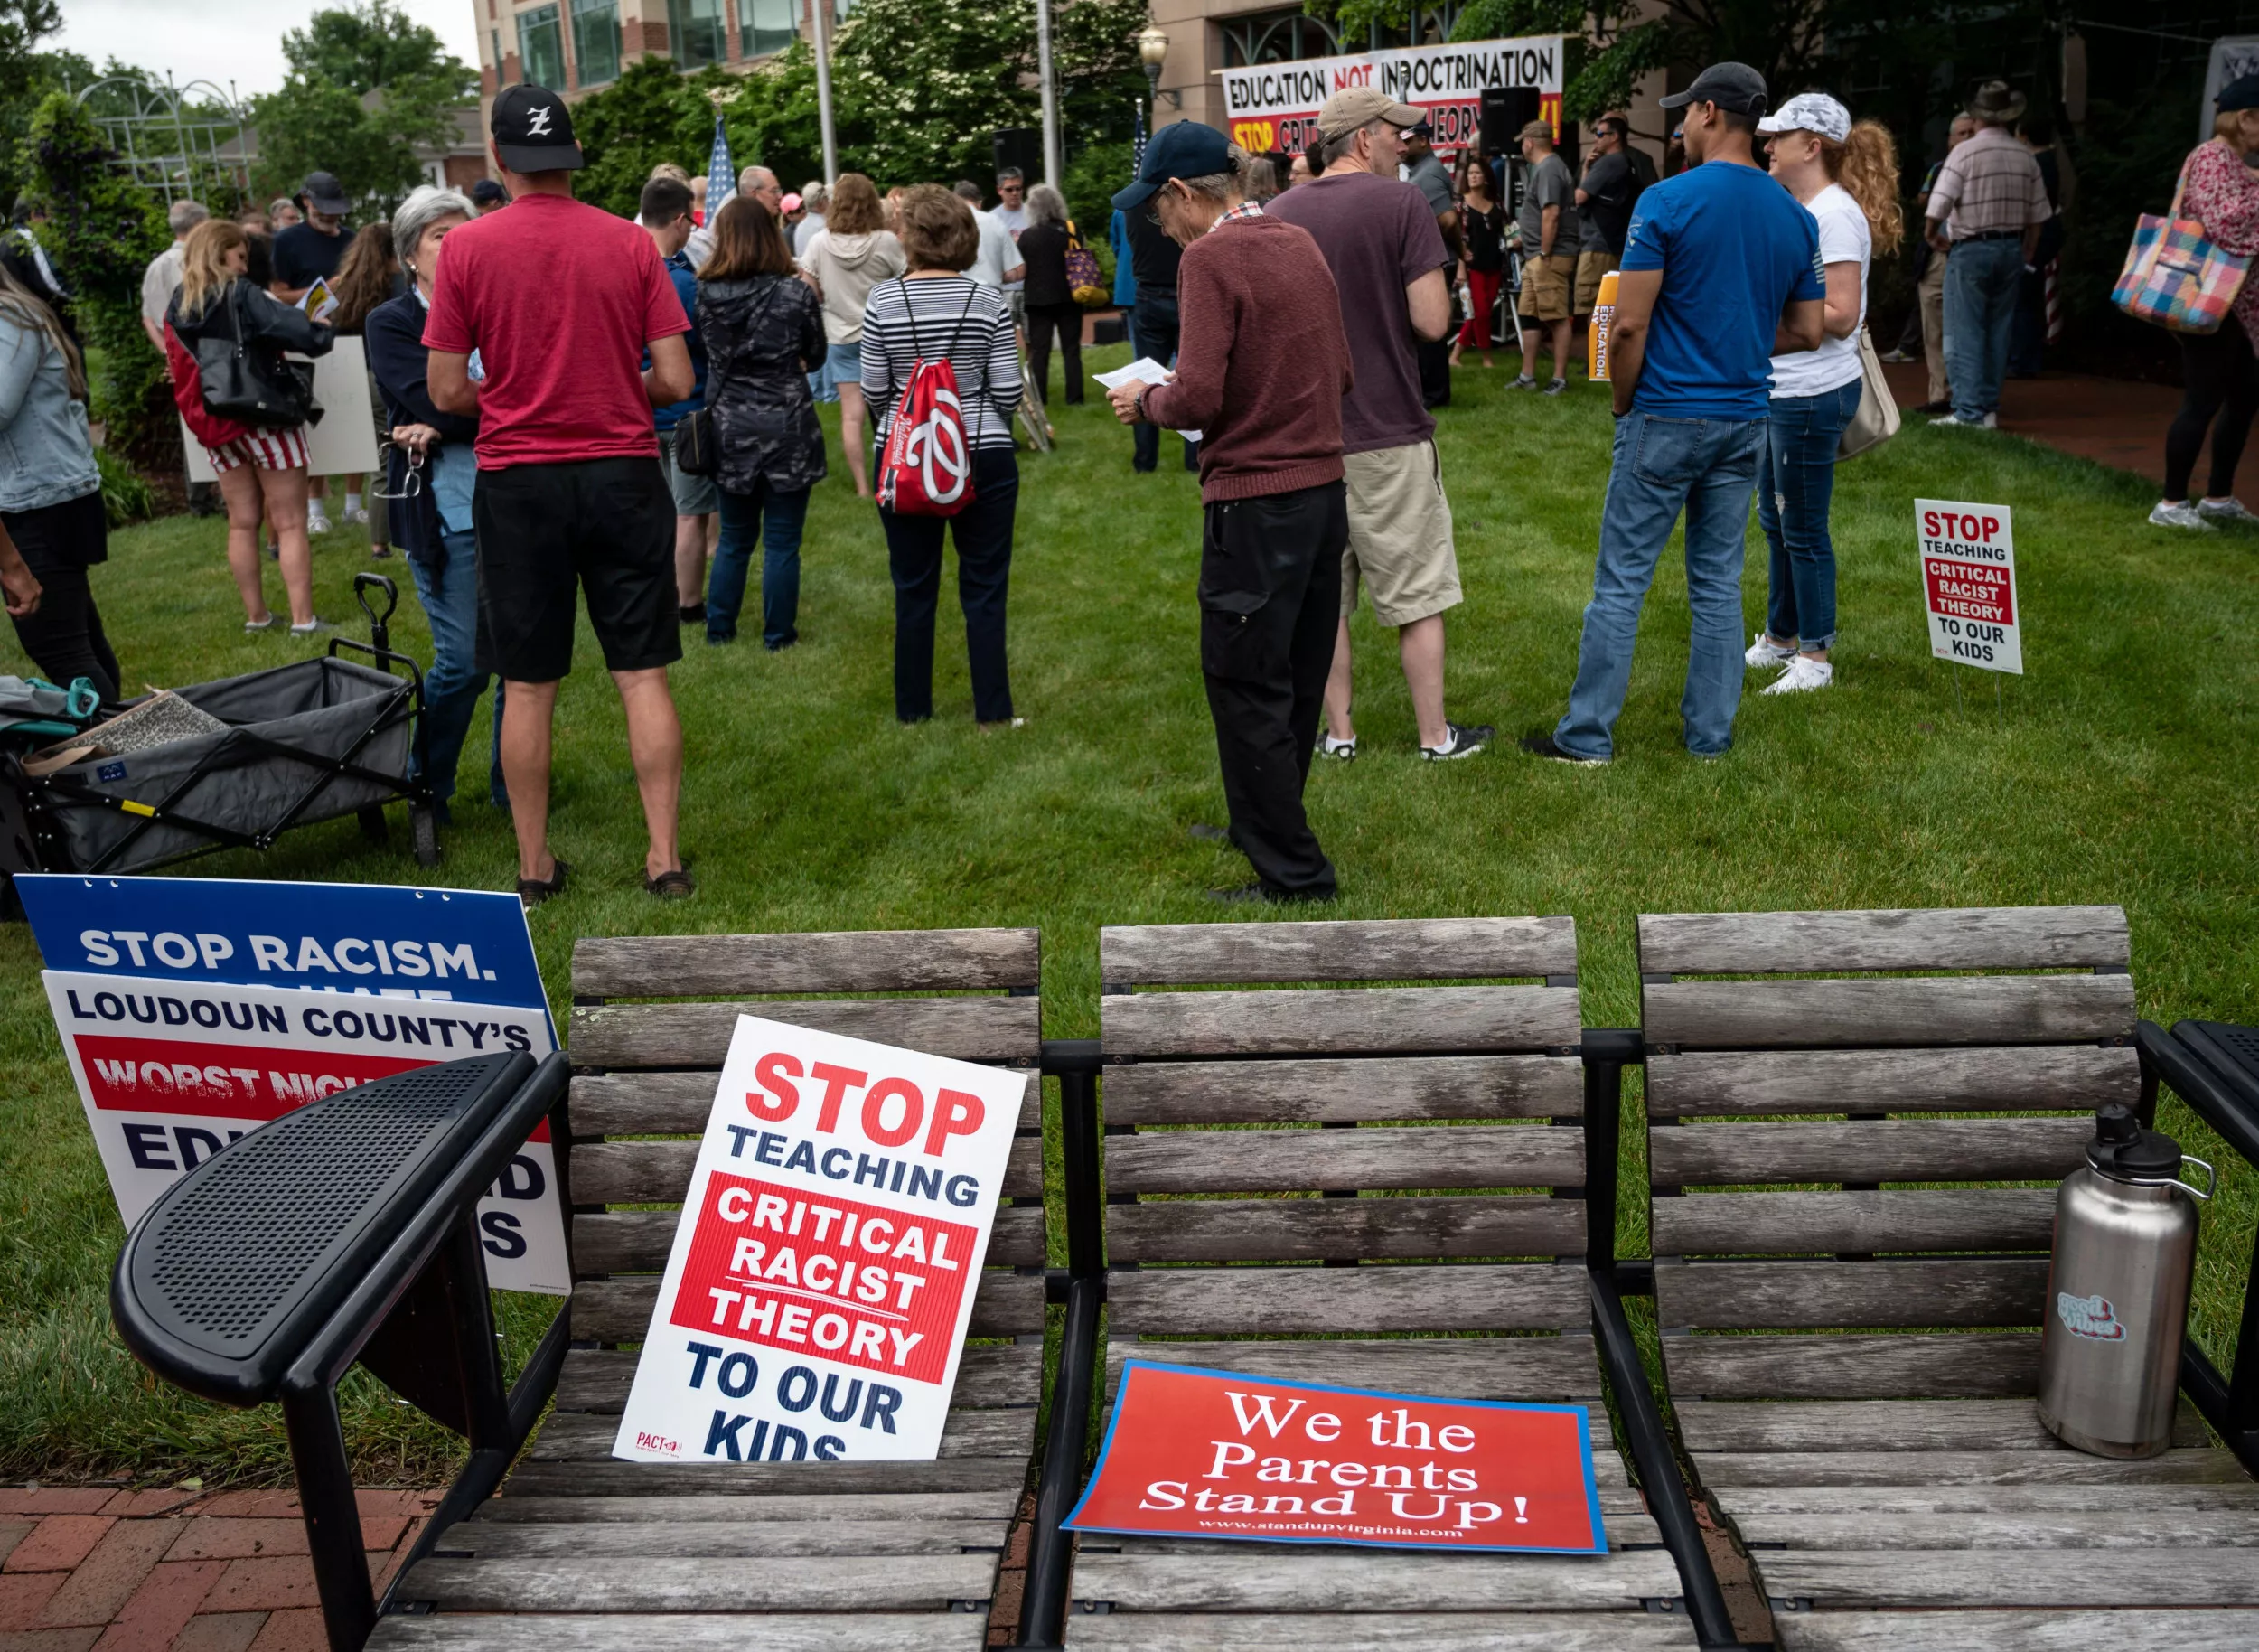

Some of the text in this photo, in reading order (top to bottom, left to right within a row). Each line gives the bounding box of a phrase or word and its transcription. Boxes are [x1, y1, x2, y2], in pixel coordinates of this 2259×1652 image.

[1229, 47, 1553, 109] EDUCATION NOT INDOCTRINATION
[526, 106, 553, 136] Z
[1233, 122, 1273, 153] STOP
[1596, 305, 1609, 378] EDUCATION
[1924, 511, 2000, 543] STOP
[1924, 540, 2006, 561] TEACHING
[1929, 561, 2008, 586] CRITICAL
[1939, 579, 2000, 601] RACIST
[1937, 597, 2004, 621] THEORY
[1938, 616, 2005, 644] TO OUR
[1952, 639, 1994, 662] KIDS
[80, 929, 497, 981] STOP RACISM.
[66, 990, 289, 1035] LOUDOUN
[303, 1008, 532, 1054] COUNTY'S
[745, 1052, 986, 1158] STOP
[727, 1124, 980, 1208] TEACHING
[717, 1187, 959, 1271] CRITICAL
[729, 1237, 926, 1310] RACIST
[708, 1288, 924, 1367] THEORY
[2059, 1297, 2106, 1317] good
[686, 1341, 904, 1435] TO OUR
[636, 1431, 667, 1450] PACT
[703, 1410, 847, 1460] KIDS
[1224, 1390, 1476, 1454] We the
[1202, 1440, 1478, 1493] Parents
[1139, 1479, 1529, 1530] Stand Up!
[1198, 1519, 1464, 1538] www.standupvirginia.com
